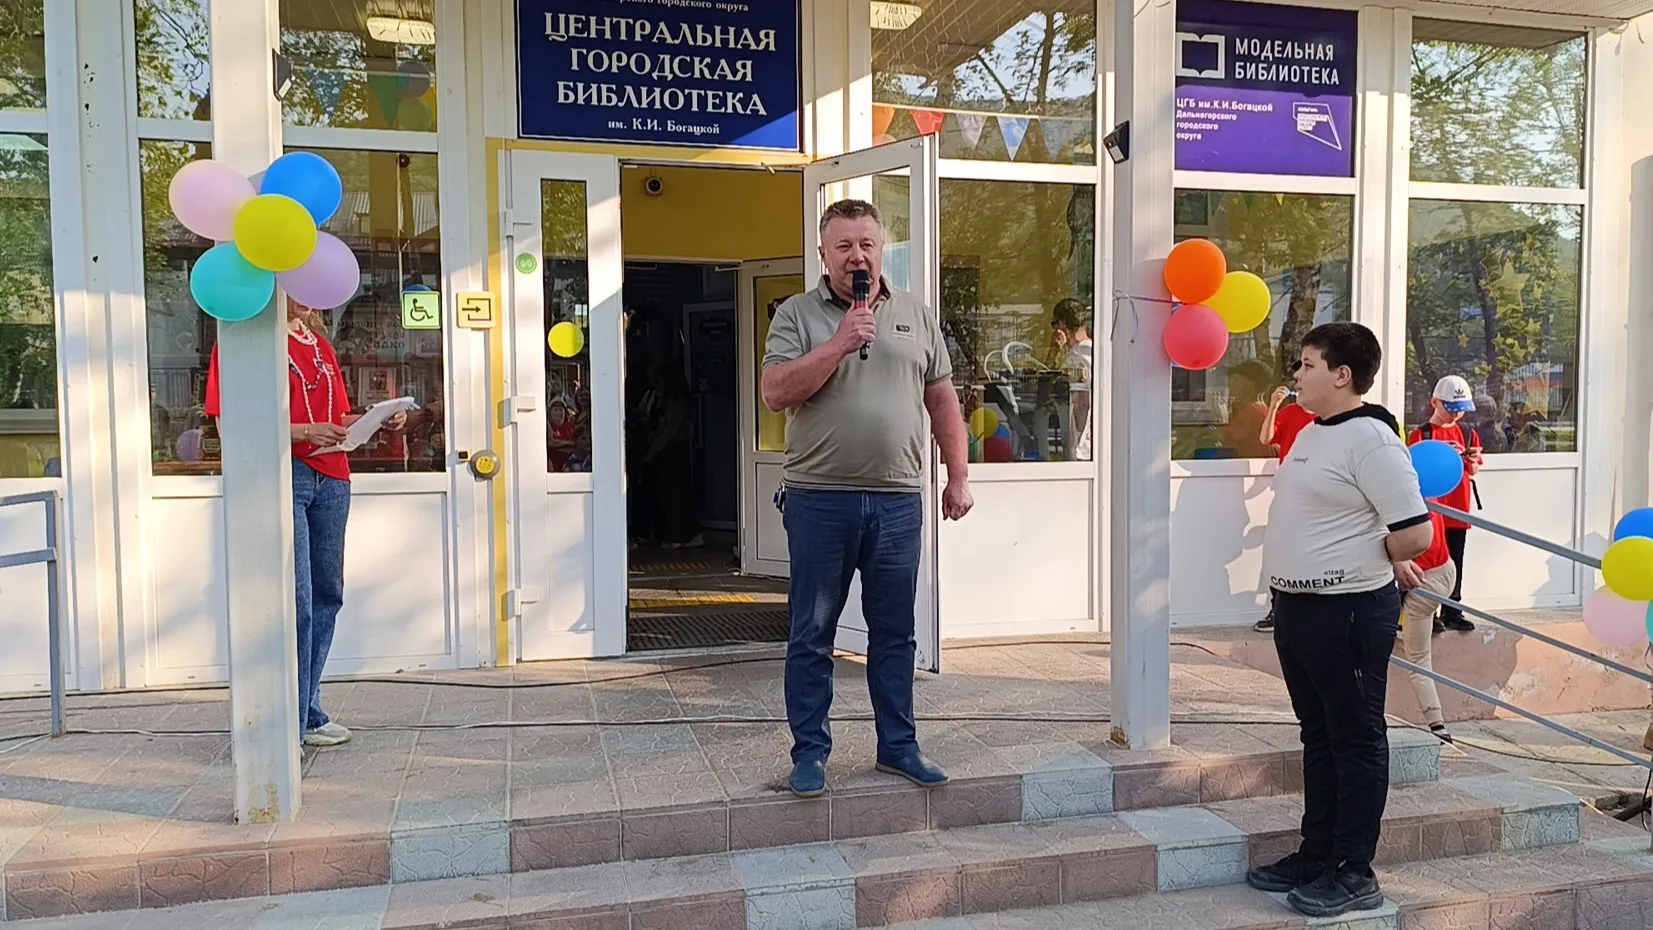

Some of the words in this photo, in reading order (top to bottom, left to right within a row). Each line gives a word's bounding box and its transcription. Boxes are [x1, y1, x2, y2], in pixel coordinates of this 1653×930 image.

[715, 3, 749, 12] округа
[544, 12, 776, 51] ЦЕНТРАЛЬНАЯ
[1235, 37, 1334, 61] МОДЕЛЬНАЯ
[570, 48, 753, 82] ГОРОДСКАЯ
[1235, 61, 1340, 85] БИБЛИОТЕКА
[557, 81, 767, 116] БИБЛИОТЕКА
[1176, 98, 1196, 108] ЦГБ
[1176, 110, 1237, 121] Дальнегорского
[608, 120, 627, 129] им.
[667, 120, 720, 136] Богацкой
[1176, 122, 1219, 130] городского
[1176, 132, 1202, 141] округа
[1270, 576, 1345, 589] COMMENT
